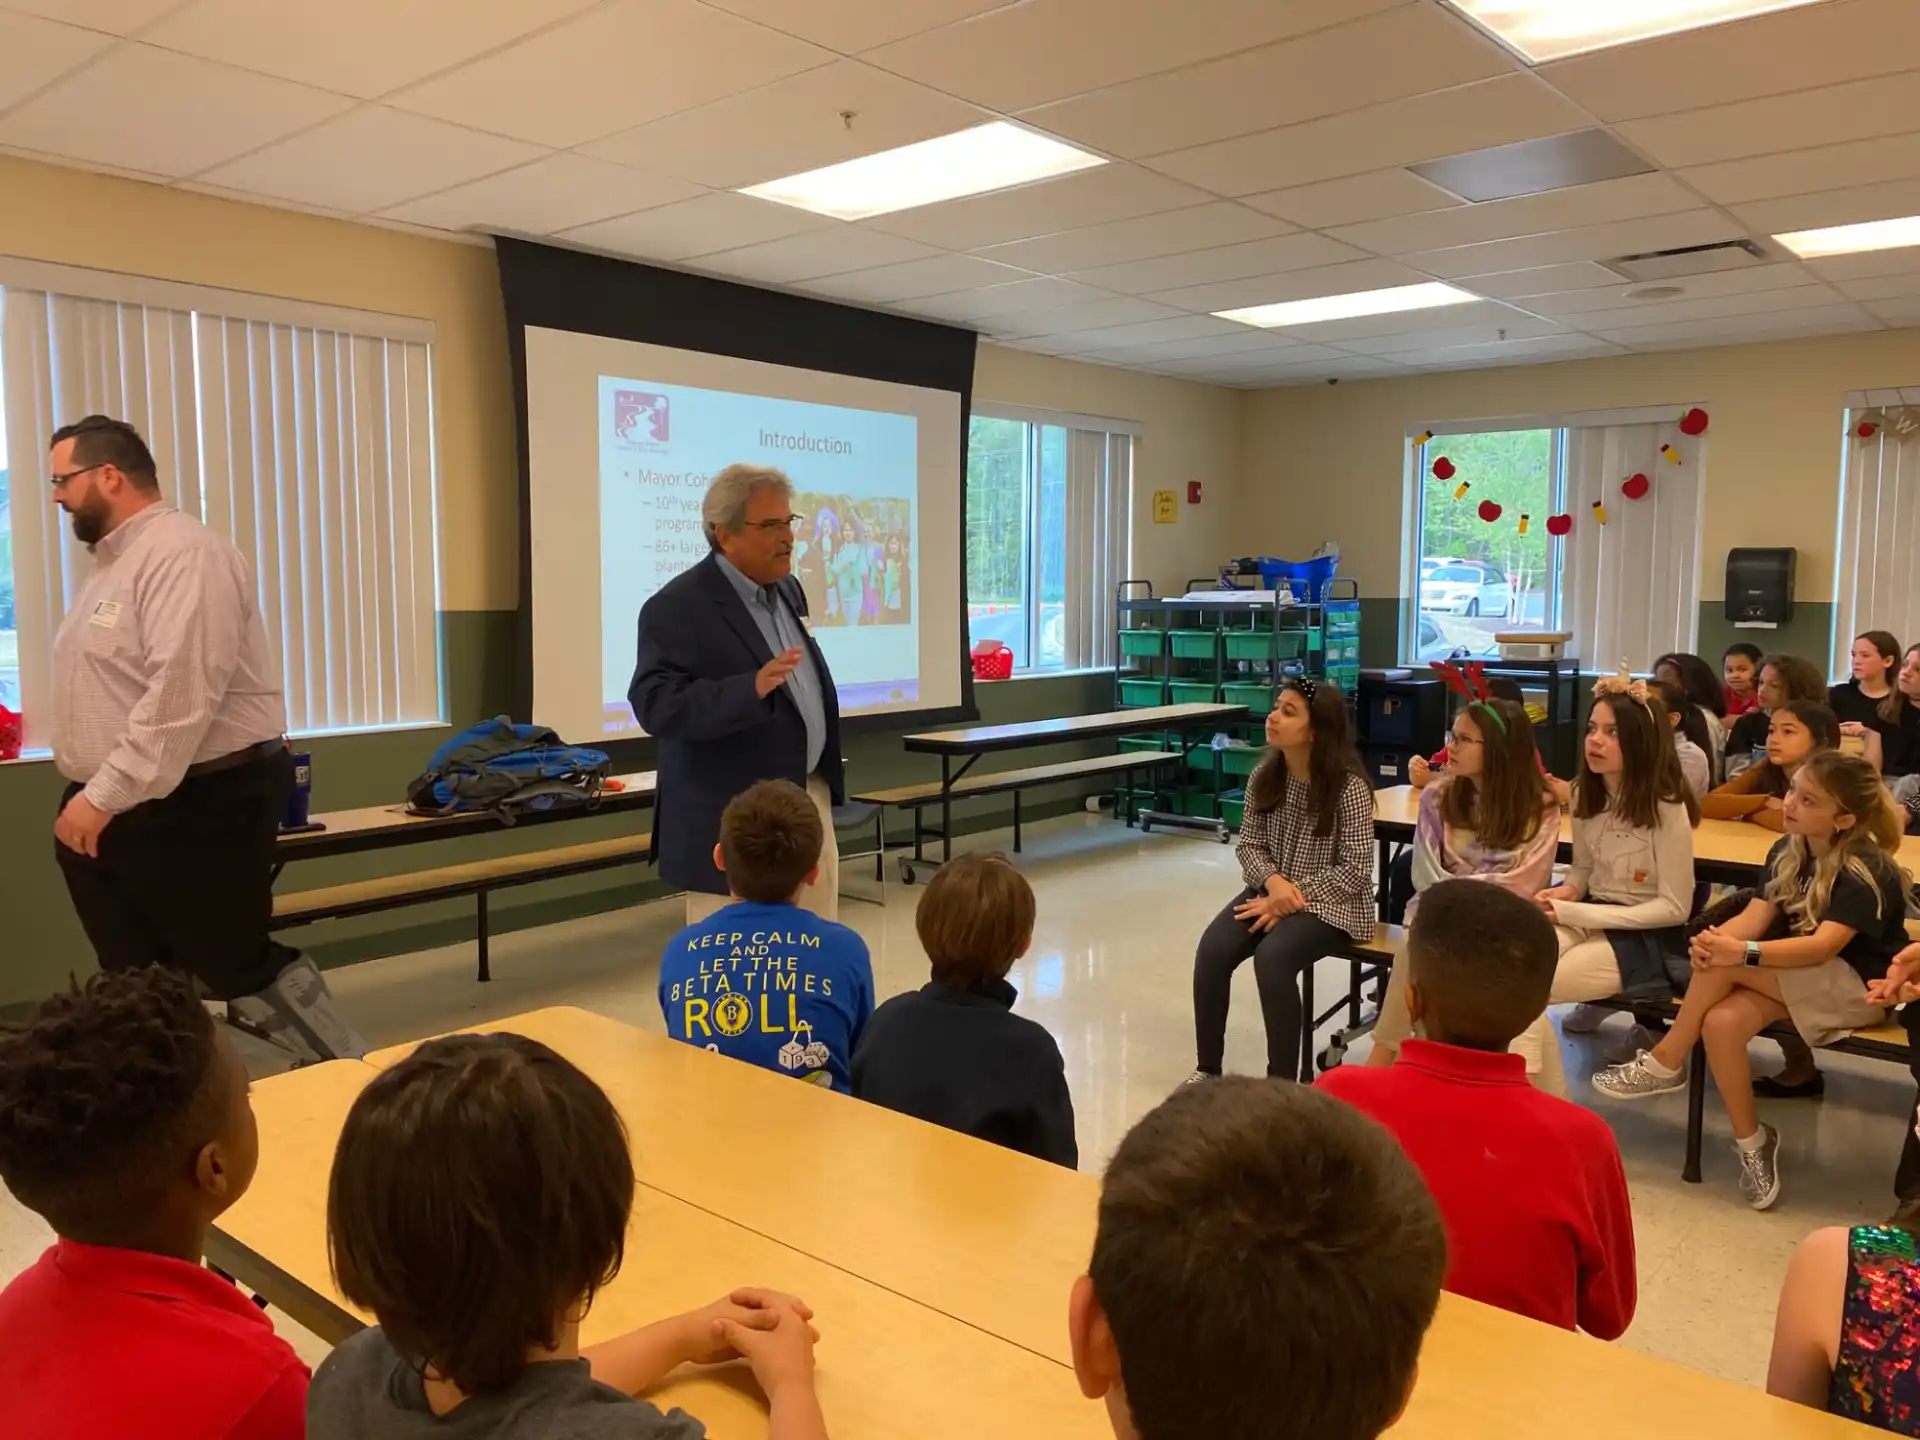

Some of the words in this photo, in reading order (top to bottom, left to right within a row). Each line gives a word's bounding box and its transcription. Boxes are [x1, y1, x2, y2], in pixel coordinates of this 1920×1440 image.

[759, 427, 852, 455] Introduction
[638, 469, 680, 488] Mayor
[687, 933, 743, 952] KEEP
[751, 931, 820, 948] CALM
[731, 945, 769, 956] AND
[700, 958, 742, 974] LET
[750, 957, 799, 971] THE
[671, 973, 731, 1001] BETA
[743, 972, 832, 996] TIMES
